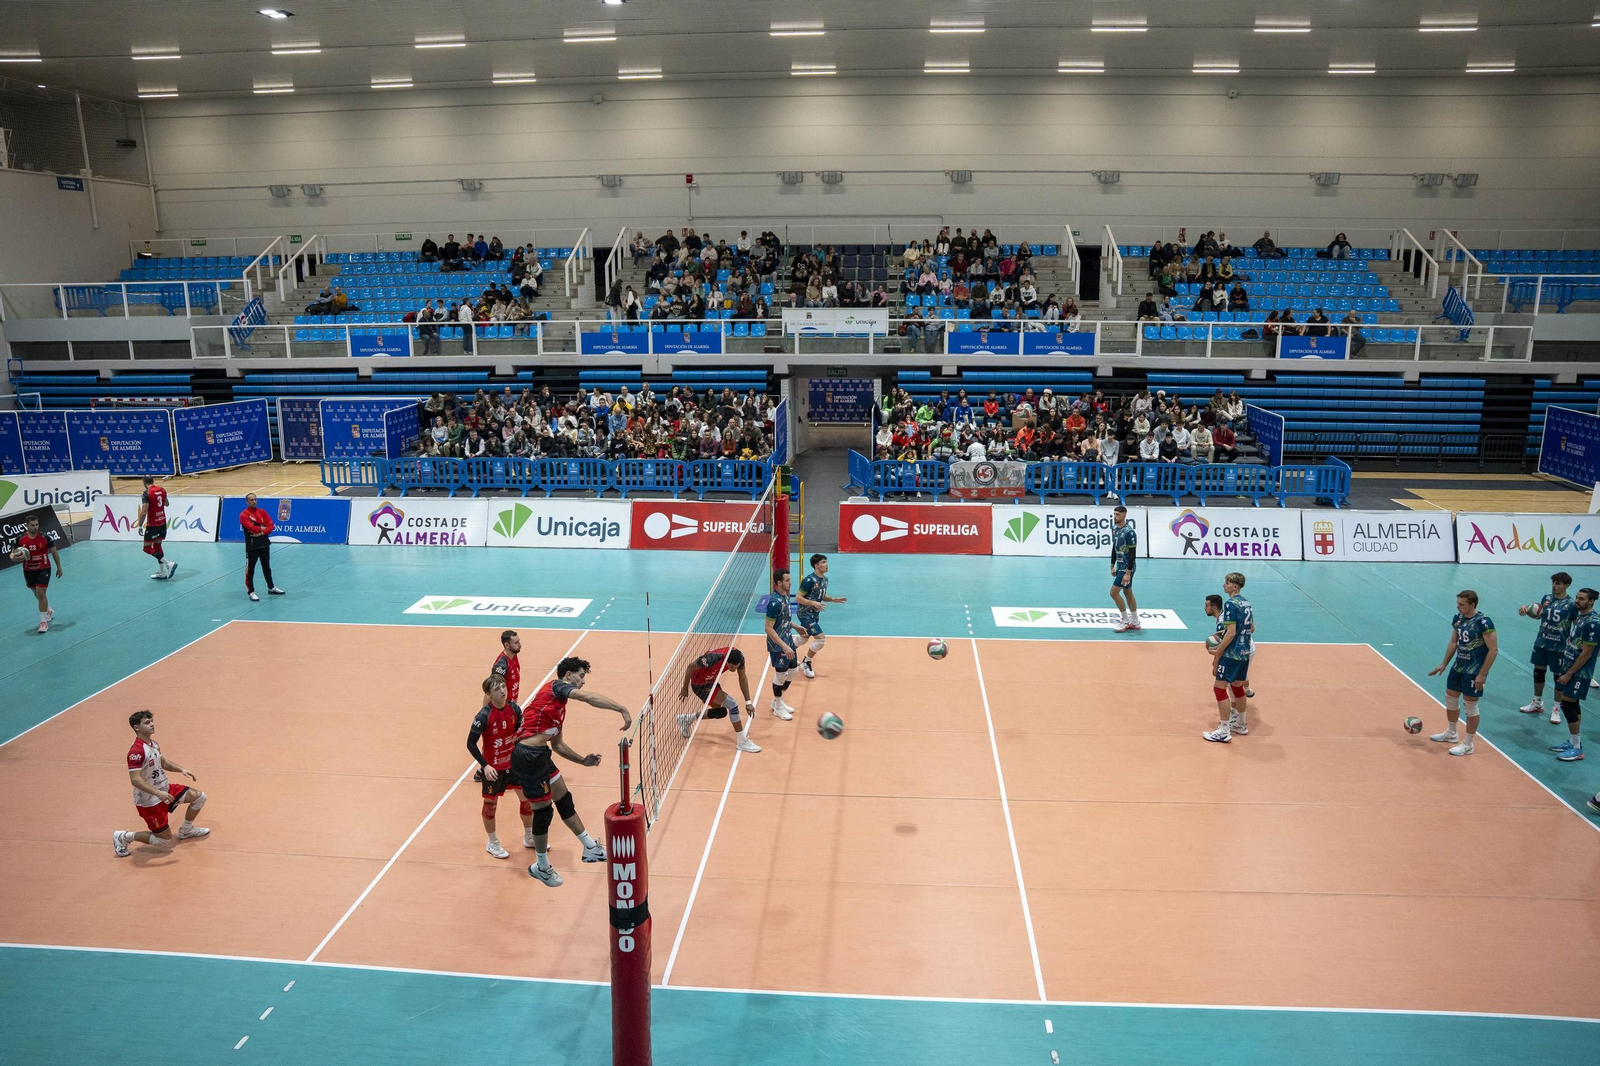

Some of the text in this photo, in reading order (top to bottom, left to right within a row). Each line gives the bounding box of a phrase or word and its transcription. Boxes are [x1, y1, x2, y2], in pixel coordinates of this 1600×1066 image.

[216, 430, 243, 439] DIPUTACIÓN
[224, 435, 243, 443] ALMERÍA
[157, 496, 162, 507] 3
[407, 517, 467, 528] COSTA DE
[1046, 514, 1136, 529] Fundacin
[295, 524, 326, 533] ALMERÍA
[537, 516, 620, 542] Unicaja
[913, 523, 978, 536] SUPERLIGA
[1214, 526, 1280, 538] COSTA DE
[1353, 519, 1440, 539] ALMERÍA
[393, 529, 467, 545] ALMERÍA
[1046, 530, 1114, 549] Unicaja
[1465, 521, 1600, 555] Andalucía
[1201, 539, 1282, 557] ALMERÍA
[1353, 541, 1398, 552] CIUDAD
[472, 603, 574, 614] Unicaja
[1056, 611, 1167, 619] Fundaón
[1547, 608, 1560, 622] 15
[1059, 617, 1122, 625] Unica
[1457, 628, 1470, 642] 16
[1217, 664, 1225, 673] 21
[1574, 681, 1581, 689] 8
[502, 720, 507, 729] 9
